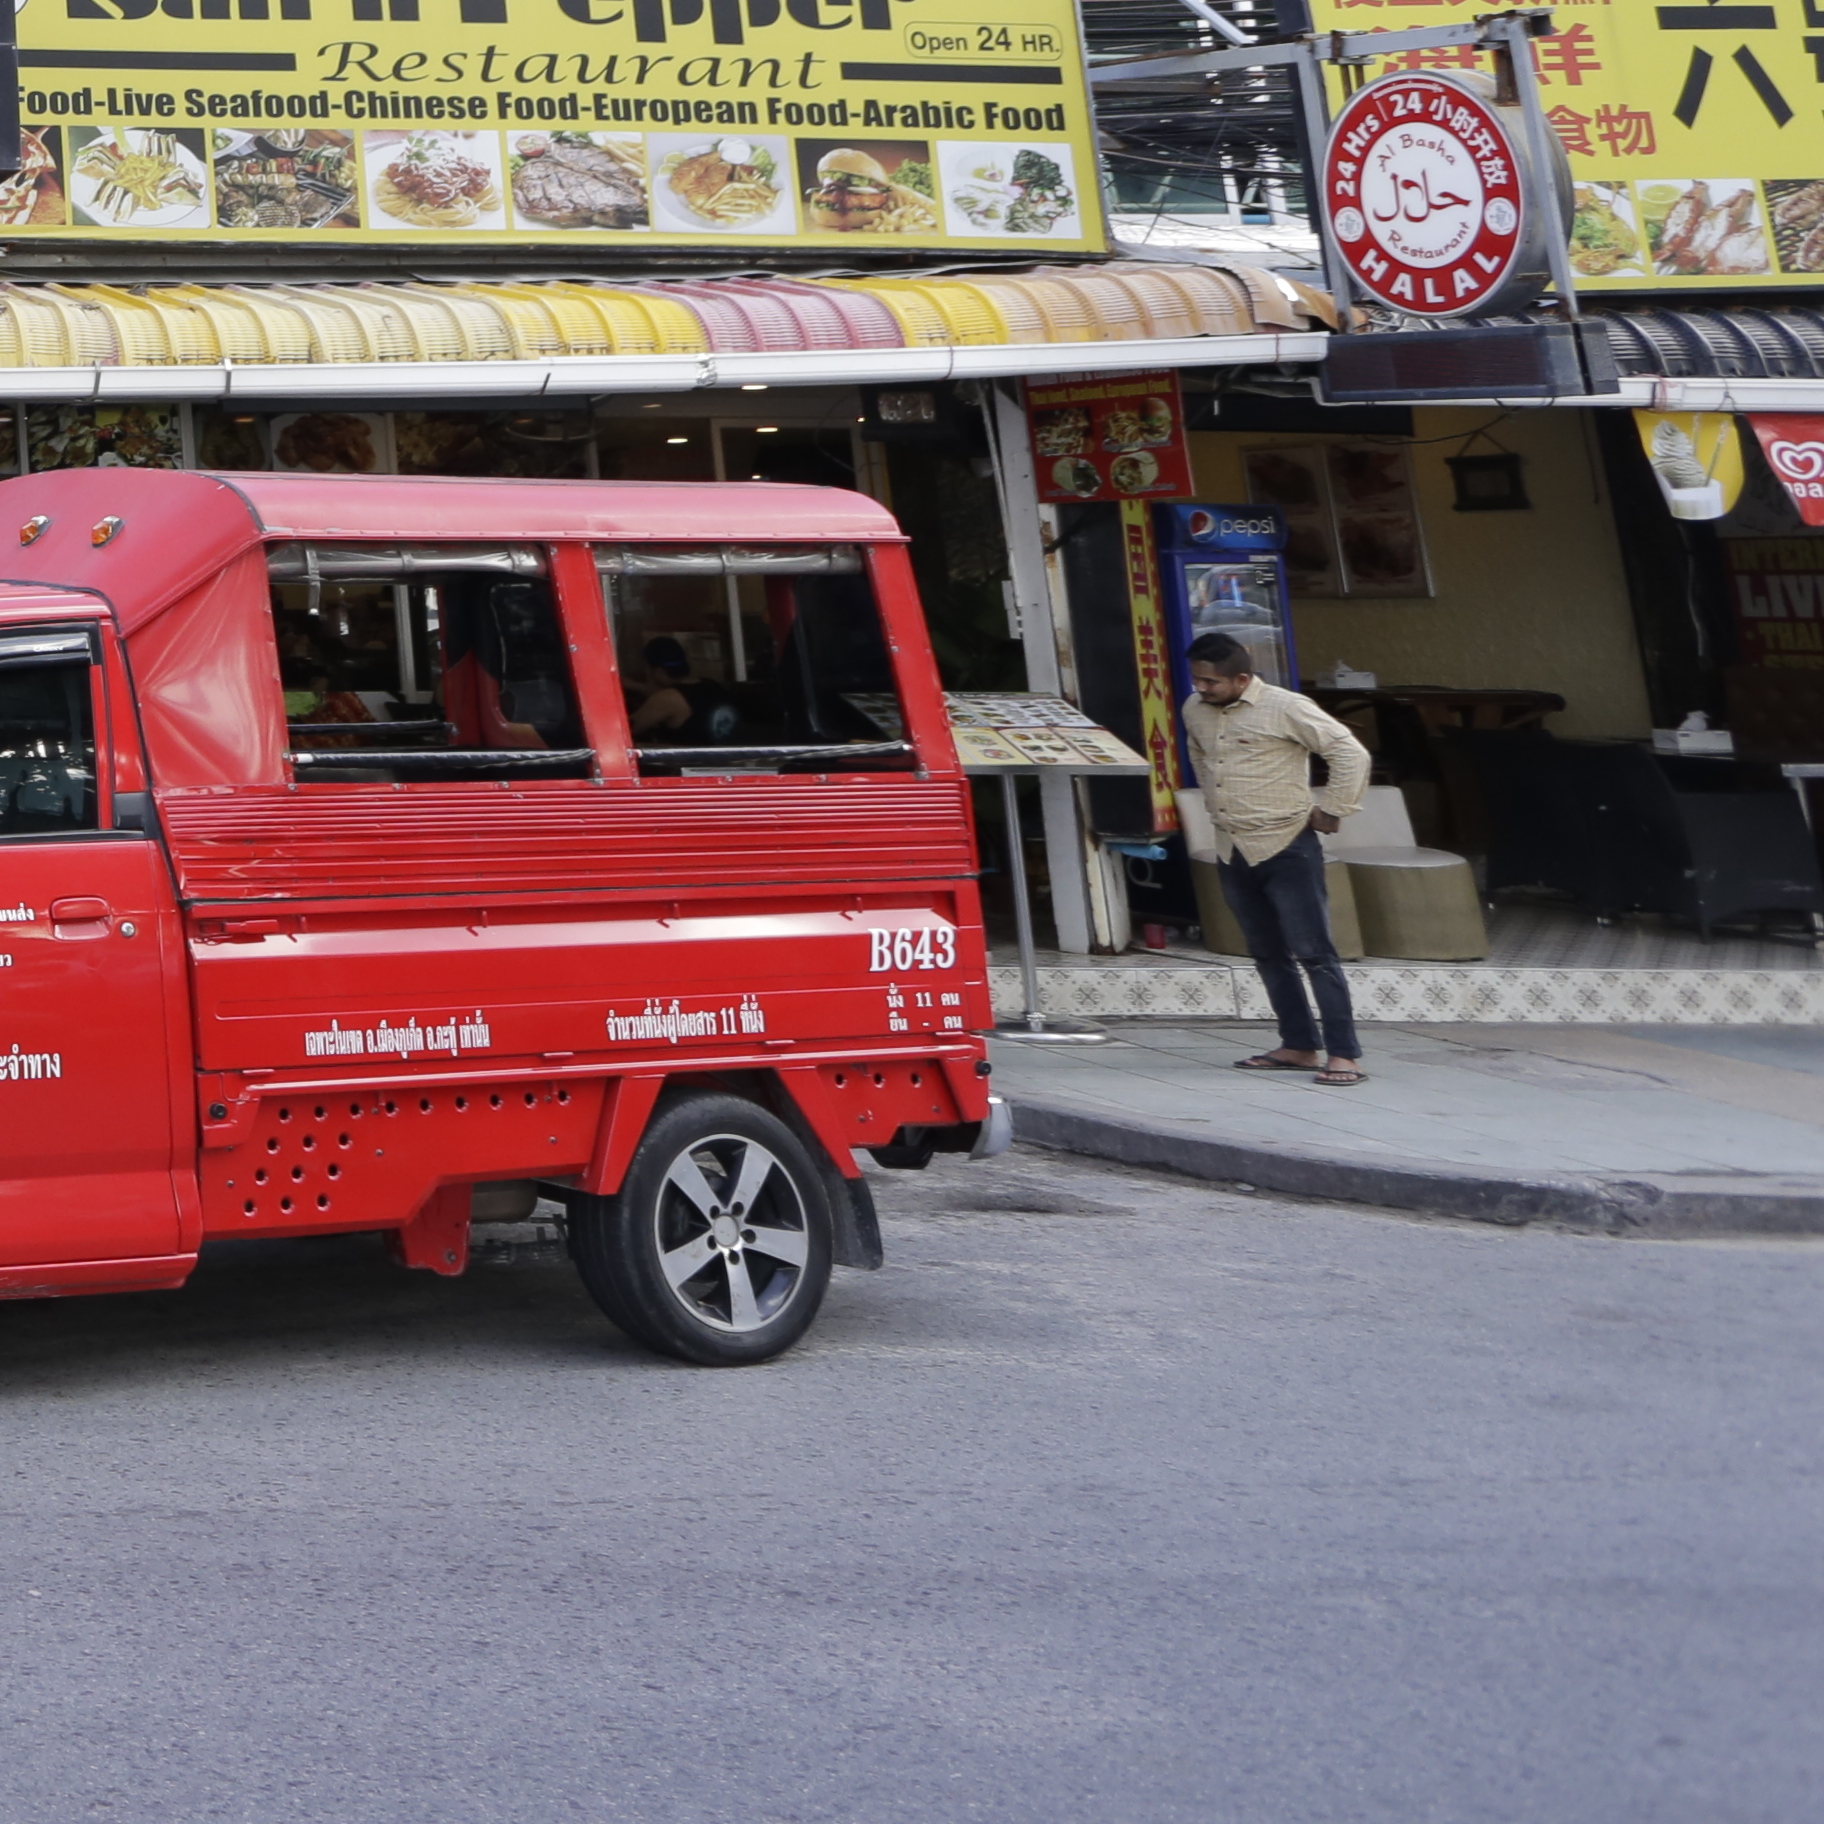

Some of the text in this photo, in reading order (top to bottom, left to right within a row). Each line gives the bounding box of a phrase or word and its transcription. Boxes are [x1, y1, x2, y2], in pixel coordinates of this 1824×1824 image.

[910, 27, 1061, 56] Open 24 HR.
[316, 41, 826, 90] Restaurant
[984, 101, 1066, 132] Food
[1336, 91, 1508, 197] 24 Hrs 24 小时开放
[1399, 133, 1455, 166] Basha
[1388, 221, 1470, 259] Restaurant
[1359, 248, 1501, 304] HALAL
[1219, 516, 1277, 537] pepsi
[1735, 574, 1824, 618] LIV
[867, 926, 957, 972] B643
[887, 982, 961, 1008] นั่ง 11 คน
[606, 994, 766, 1044] จำนวนที่นั่งผู้โดยสาร 11 ที่นั่ง
[889, 1010, 964, 1032] ยืน คน
